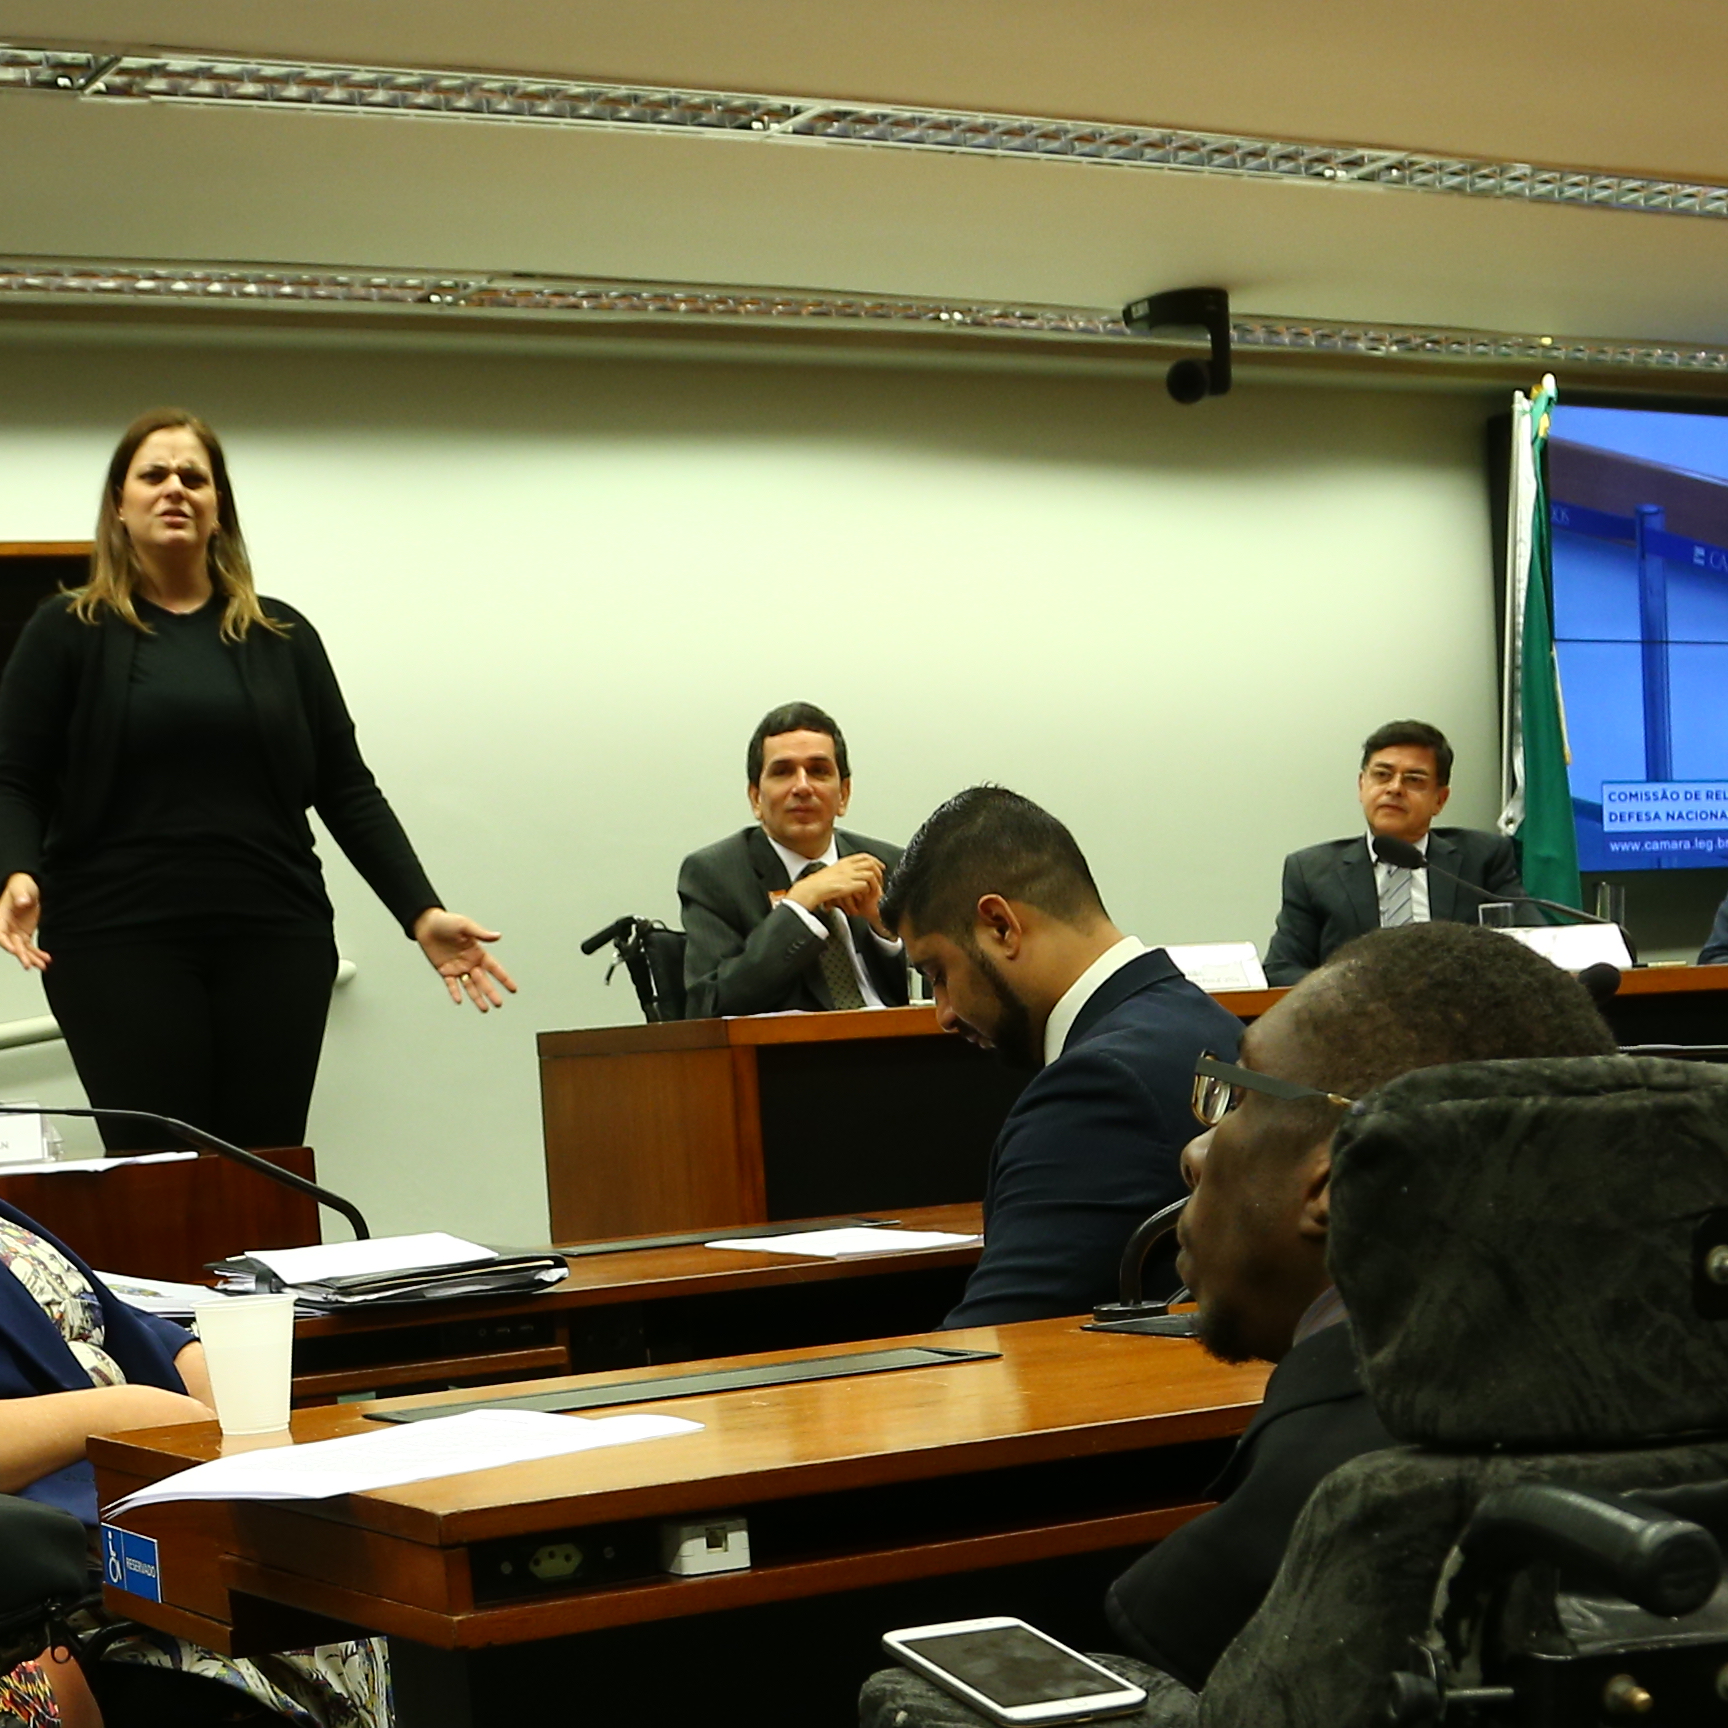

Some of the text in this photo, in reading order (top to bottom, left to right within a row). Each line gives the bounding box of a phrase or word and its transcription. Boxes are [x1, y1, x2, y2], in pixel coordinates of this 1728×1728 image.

[1608, 788, 1680, 801] COMISSÃO
[1684, 789, 1701, 801] DE
[1609, 811, 1662, 822] DEFESA
